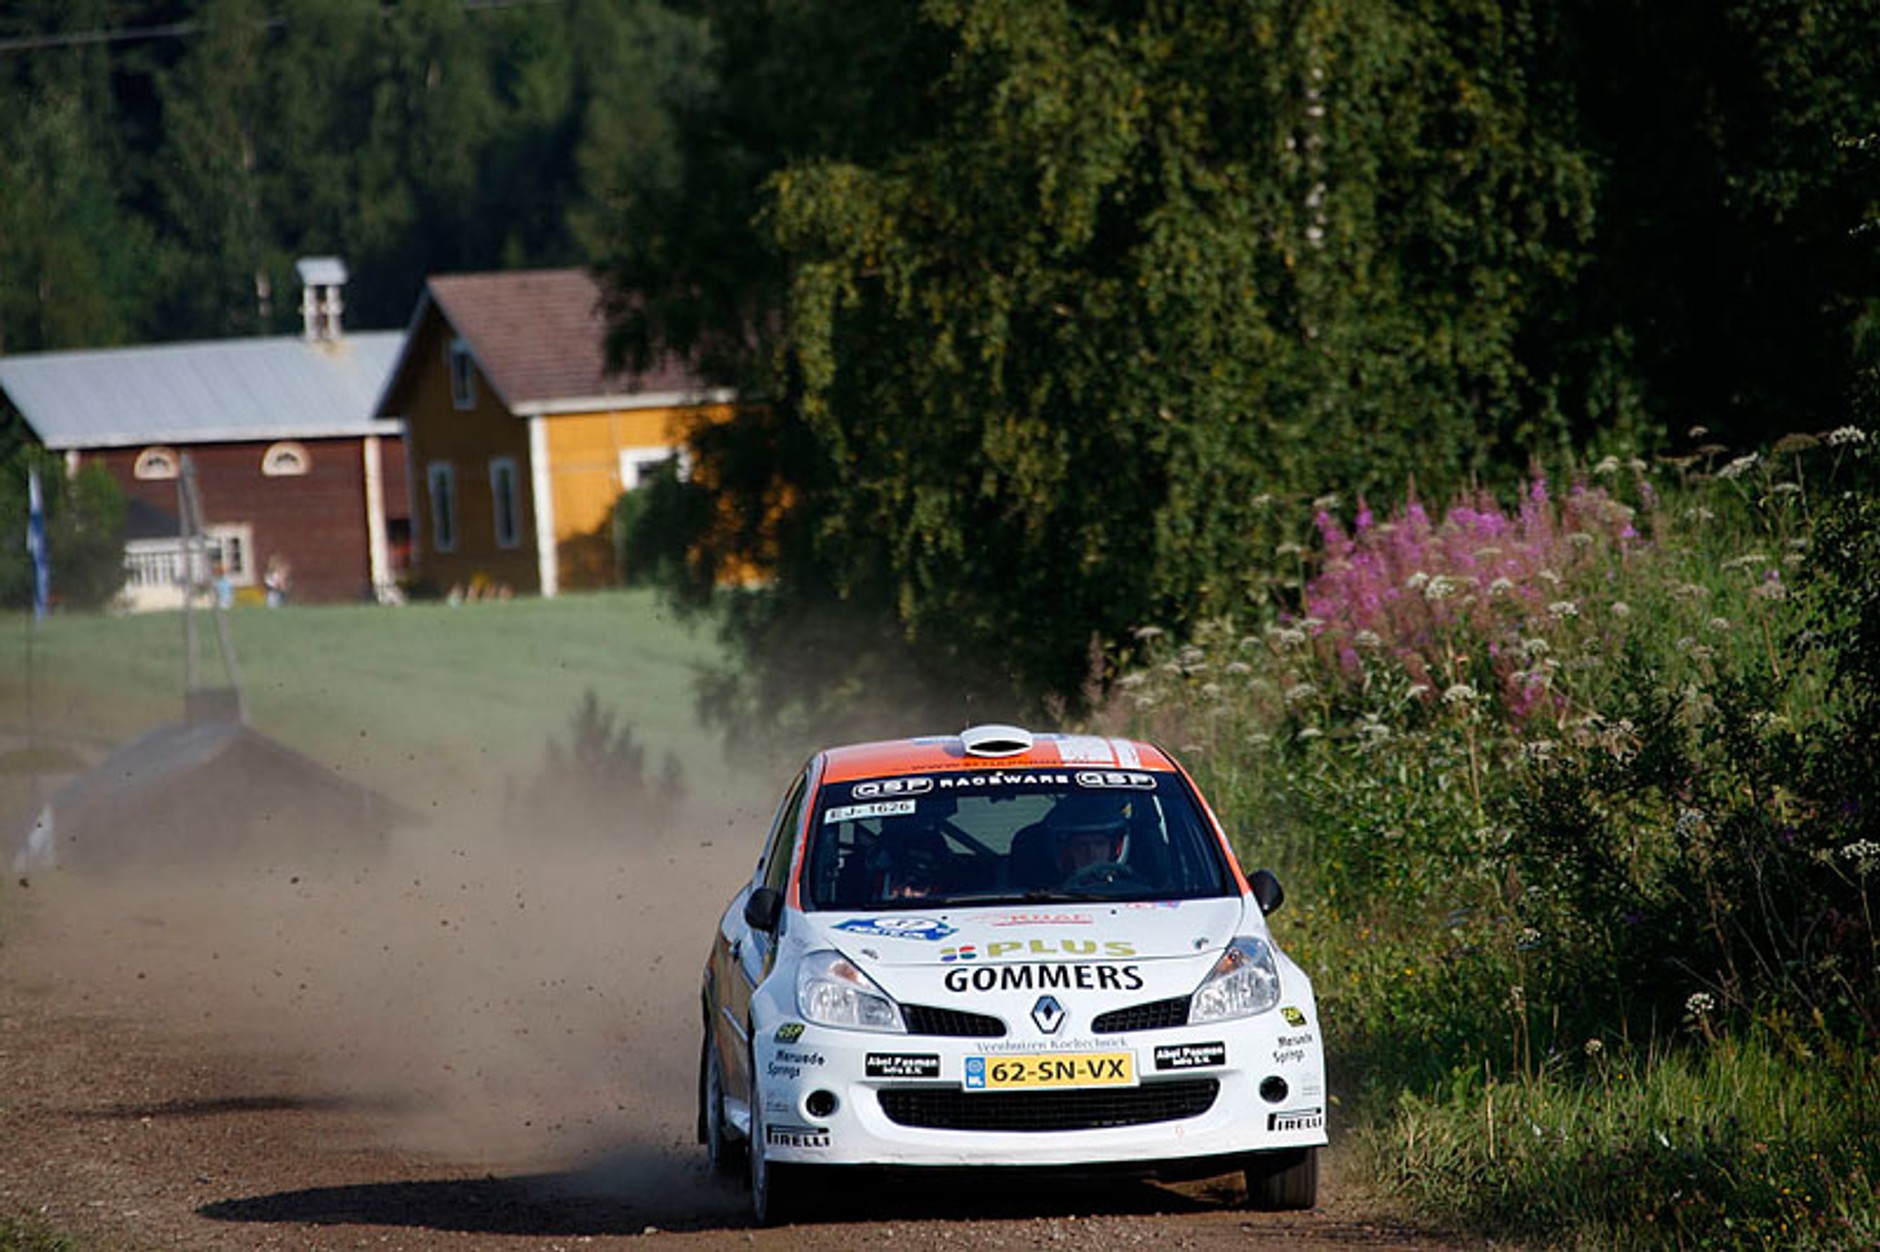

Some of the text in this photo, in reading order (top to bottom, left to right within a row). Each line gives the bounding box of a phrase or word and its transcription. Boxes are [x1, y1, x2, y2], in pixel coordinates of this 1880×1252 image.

[940, 774, 1069, 788] RACEWARE
[830, 803, 911, 818] EJ-1626
[987, 939, 1136, 957] PLUS
[944, 965, 1144, 992] GOMMERS
[991, 1059, 1125, 1082] 62-SN-VX
[1267, 1106, 1322, 1131] PIRELLI
[766, 1123, 830, 1147] PIRELLI
